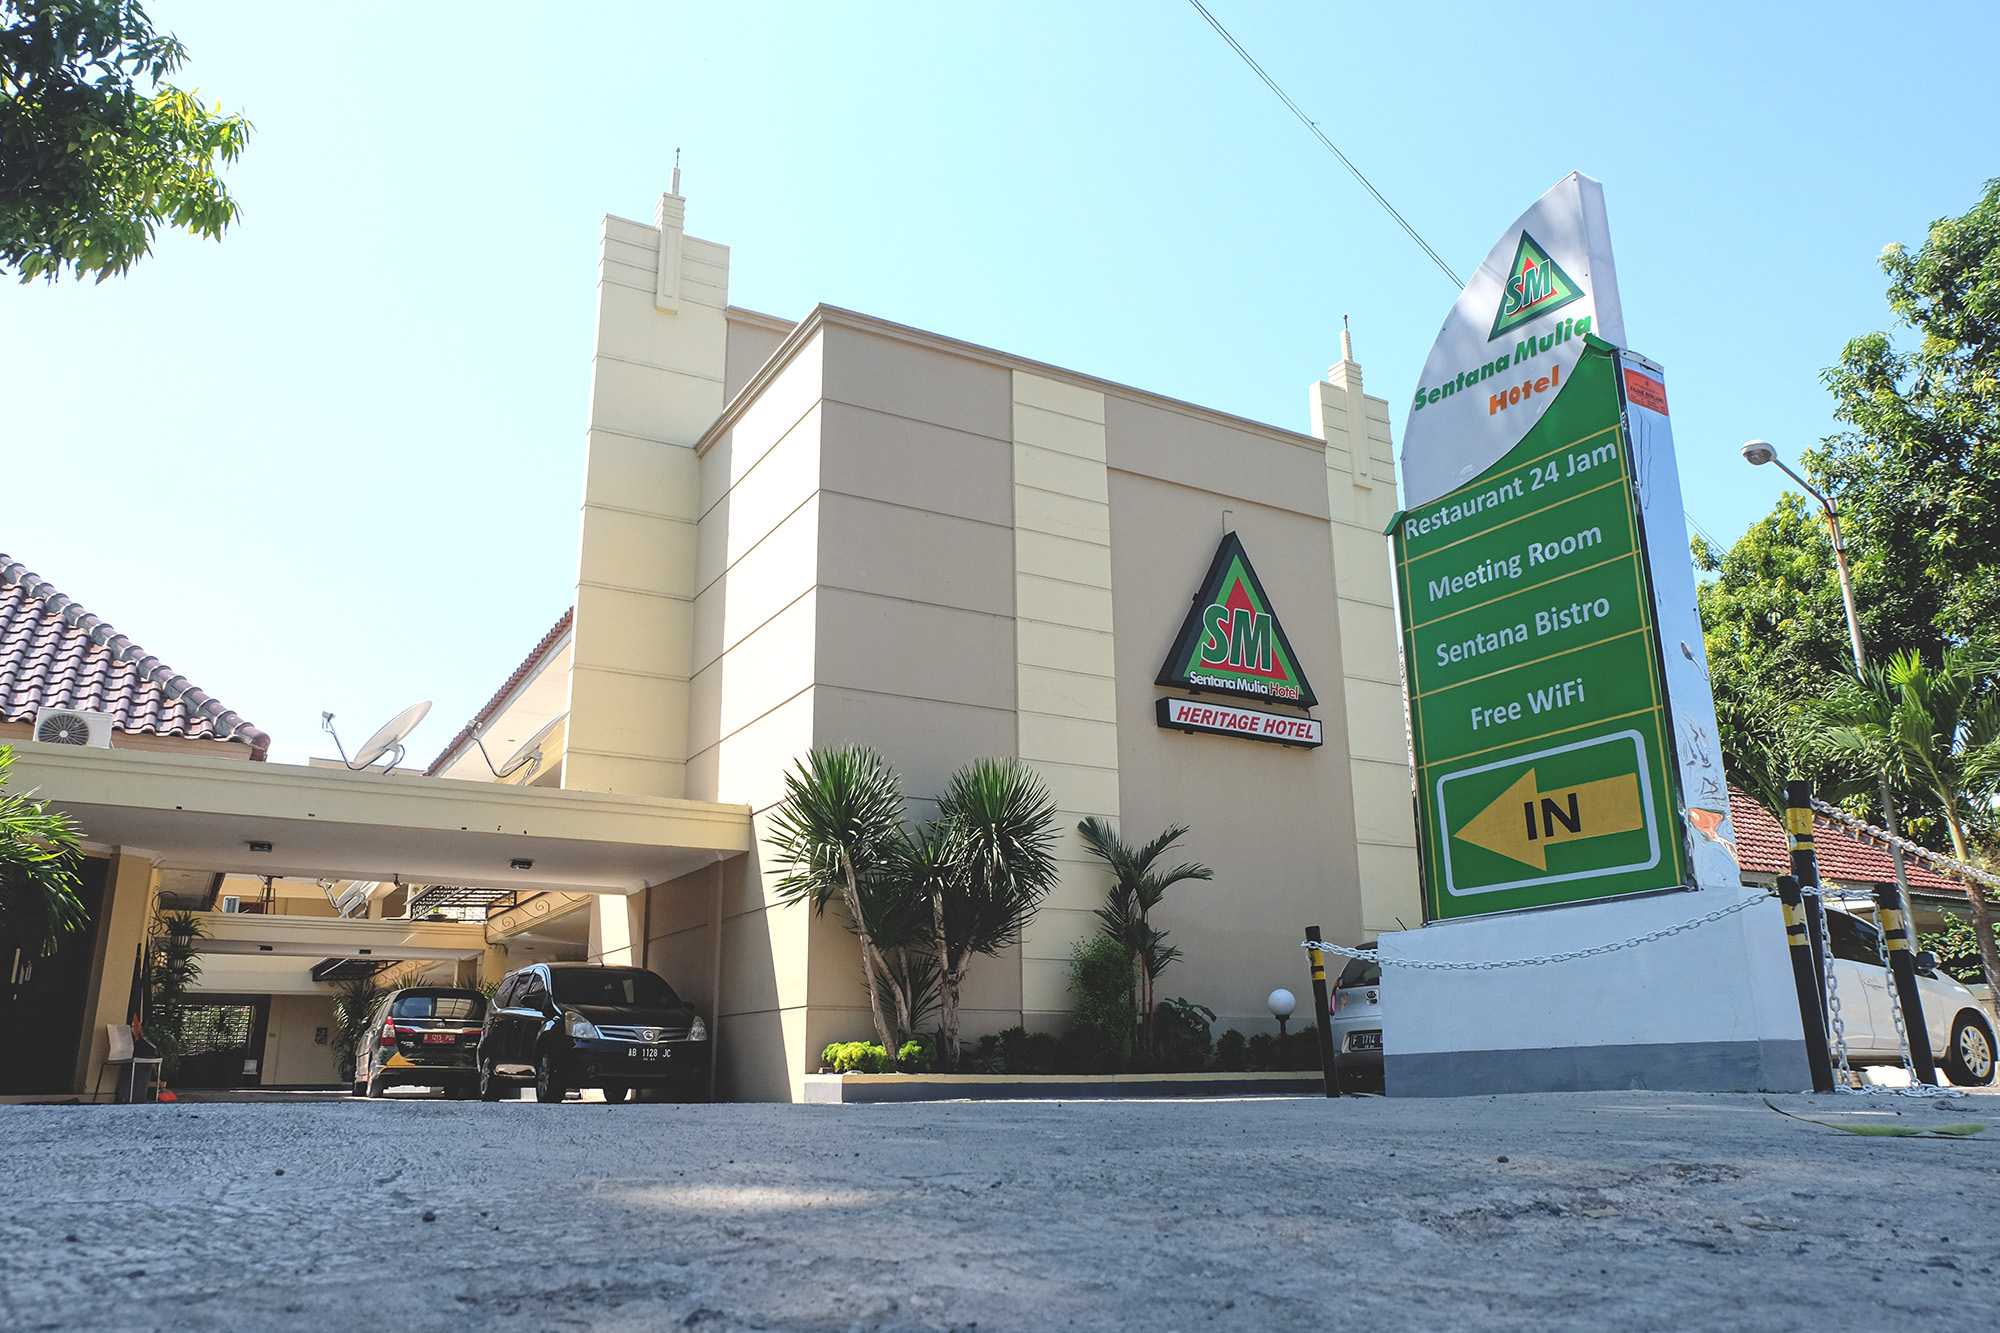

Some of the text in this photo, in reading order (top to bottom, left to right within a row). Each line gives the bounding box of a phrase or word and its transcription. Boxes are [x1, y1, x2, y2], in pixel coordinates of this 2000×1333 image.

[1505, 259, 1552, 315] SM
[1415, 316, 1591, 411] Sentana Mulia
[1489, 364, 1559, 415] Hotel
[1404, 443, 1617, 540] Restaurant 24 Jam
[1428, 526, 1602, 602] Meeting Room
[1201, 604, 1272, 672] SM
[1436, 598, 1610, 667] Sentana Bistro
[1189, 671, 1300, 700] Sentana Mulia Hotel
[1470, 677, 1585, 731] Free WiFi
[1177, 706, 1314, 740] HERITAGE HOTEL
[1523, 792, 1581, 841] IN
[628, 1048, 671, 1058] AB 1128 JC
